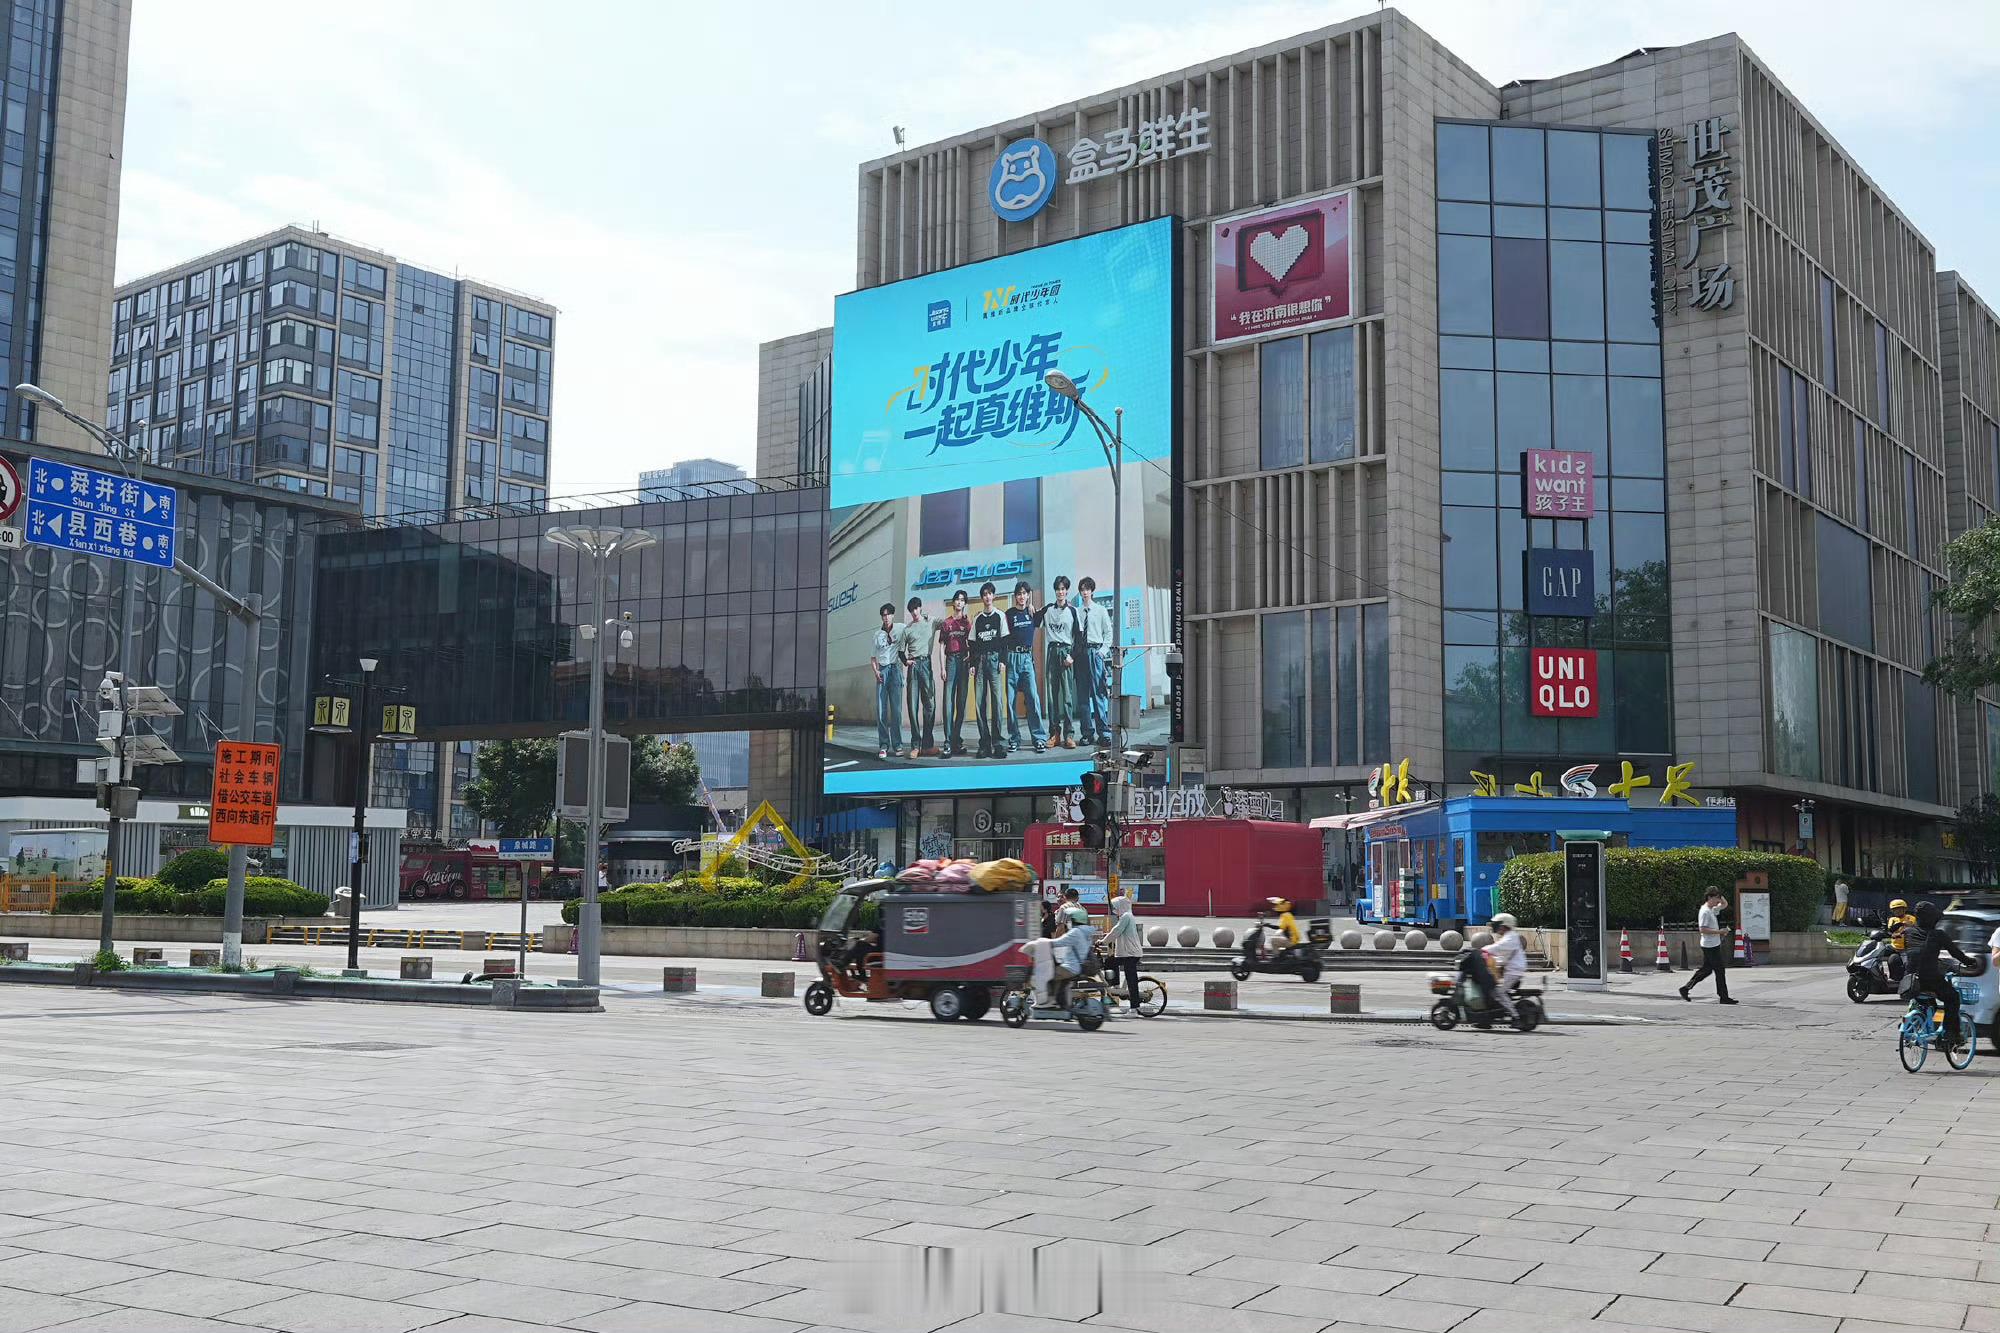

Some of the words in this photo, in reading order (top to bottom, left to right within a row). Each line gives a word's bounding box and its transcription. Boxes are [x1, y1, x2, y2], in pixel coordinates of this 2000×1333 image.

[1066, 107, 1212, 185] 盒马鲜生
[1659, 127, 1674, 189] SHIMAO
[1681, 116, 1735, 312] 世茂广场
[1660, 199, 1677, 274] FESTIVAL
[1662, 277, 1678, 315] CITY
[904, 369, 1091, 457] 一起真维斯
[1534, 453, 1586, 475] kids
[35, 468, 47, 483] 北
[36, 484, 45, 494] N
[70, 470, 139, 507] 舜井街
[1535, 477, 1586, 494] want
[72, 496, 94, 509] Shun
[159, 495, 171, 510] 南
[1535, 495, 1586, 512] 孩子王
[32, 509, 45, 525] 北
[161, 510, 168, 520] S
[33, 526, 42, 535] N
[68, 511, 137, 547] 县西巷
[157, 534, 169, 549] 南
[123, 549, 134, 558] Rd
[159, 549, 167, 559] S
[914, 556, 1032, 587] Jeanswest
[1542, 566, 1582, 598] GAP
[1175, 614, 1183, 646] naked
[1538, 655, 1585, 680] UNI
[1539, 685, 1590, 711] QLO
[220, 749, 276, 767] 施工期间
[219, 768, 274, 786] 社会车辆
[217, 789, 273, 807] 借公交车道
[1705, 796, 1736, 807] 便利店
[215, 808, 272, 826] 西向东通行
